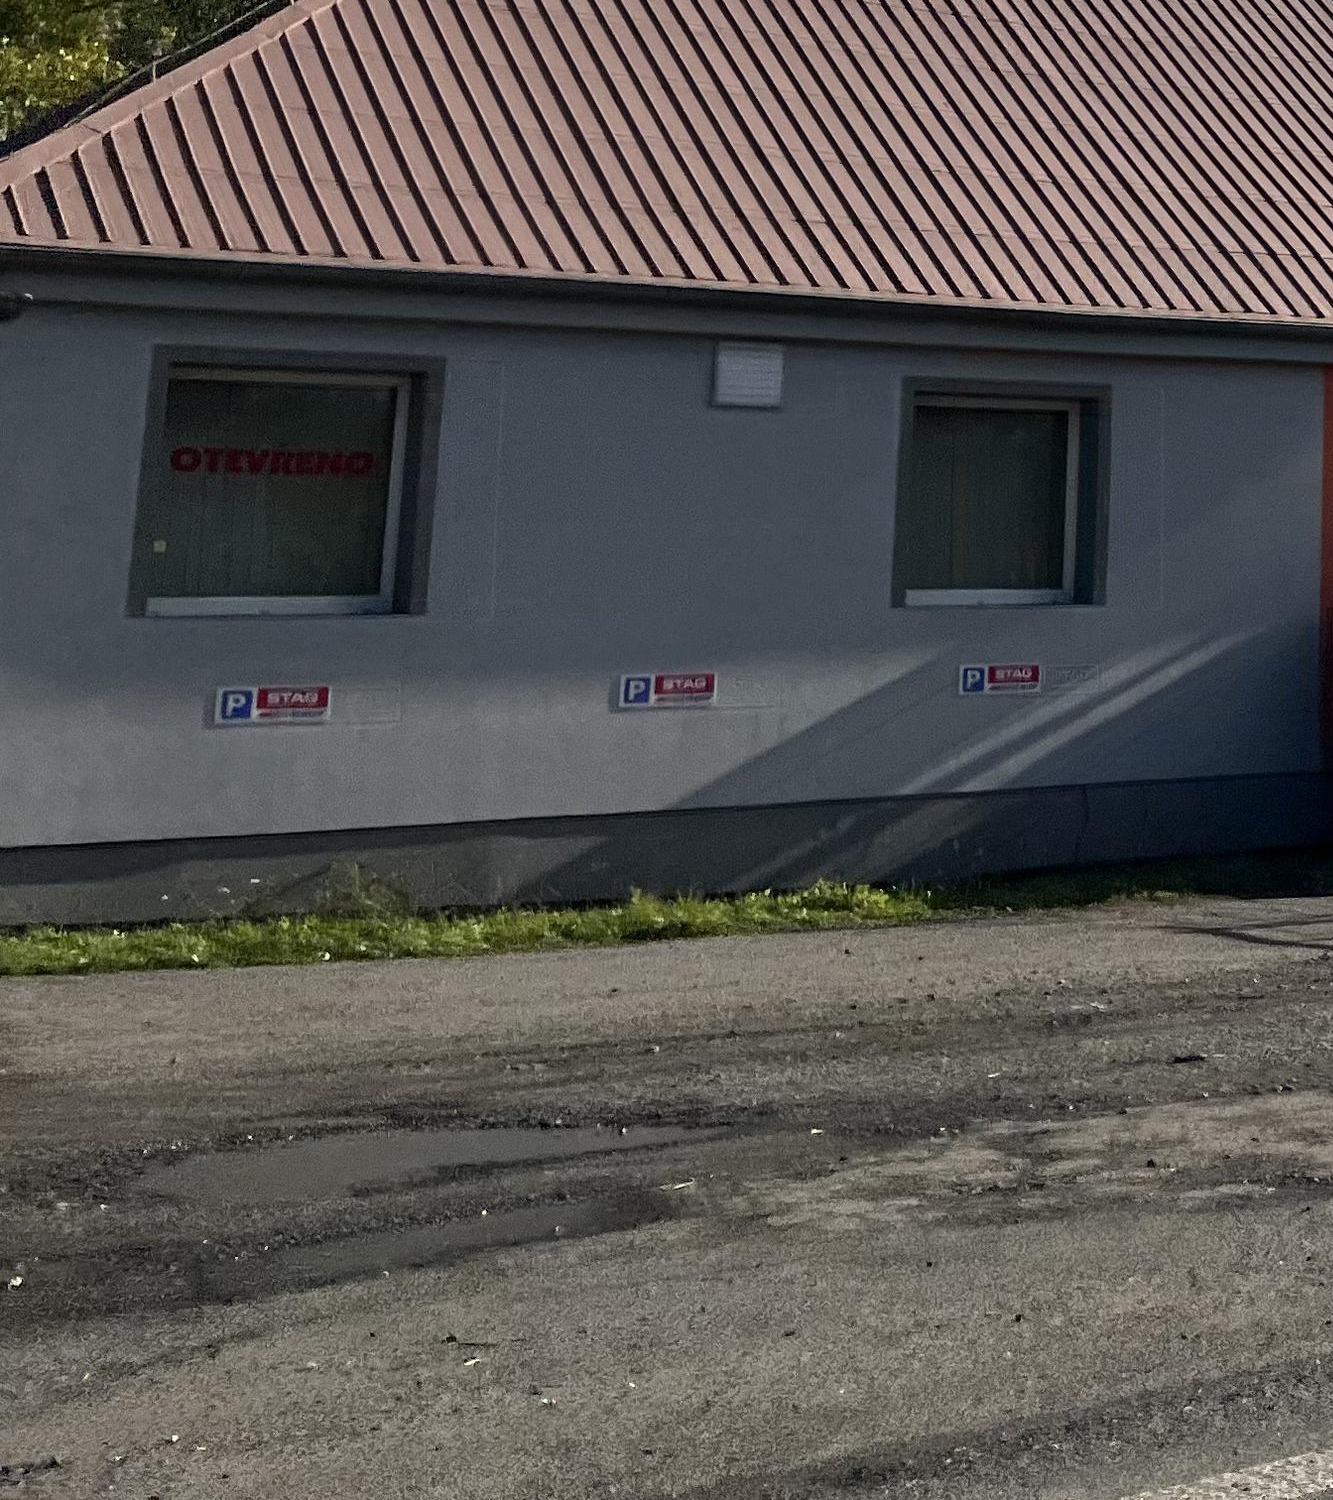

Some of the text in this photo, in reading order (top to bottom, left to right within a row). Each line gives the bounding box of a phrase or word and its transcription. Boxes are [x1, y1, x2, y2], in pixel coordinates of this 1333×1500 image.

[966, 670, 980, 689] P
[629, 681, 646, 700] P
[226, 694, 246, 716] P
